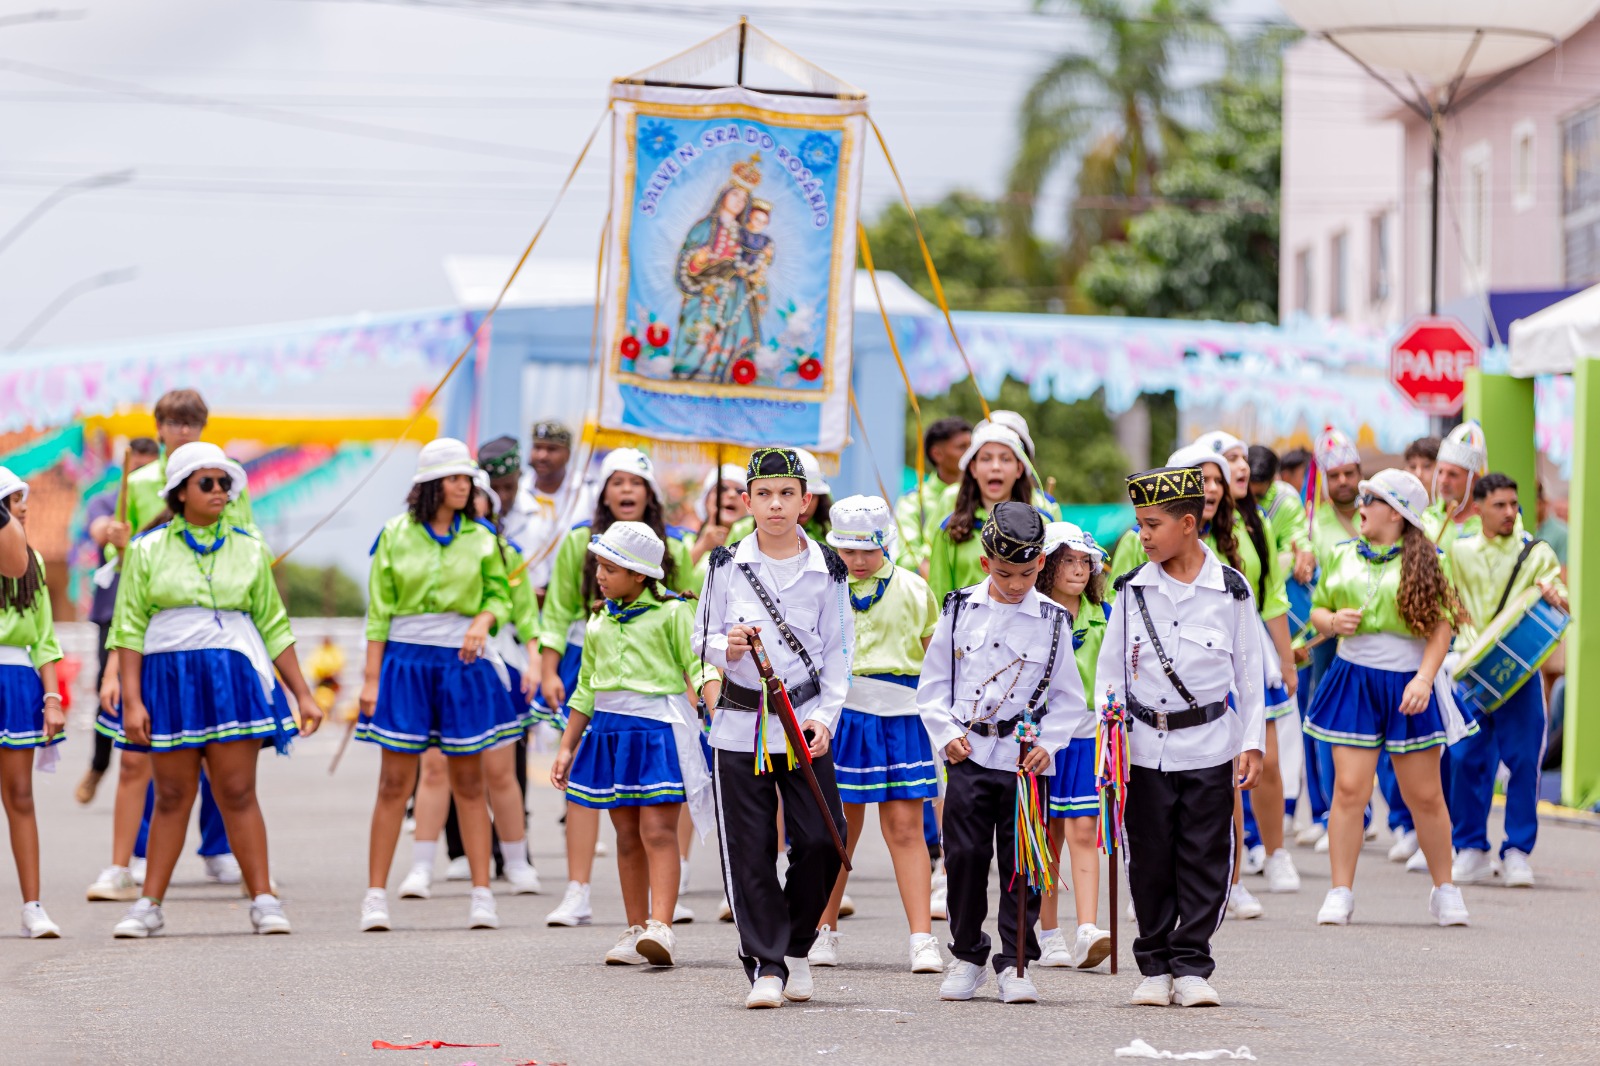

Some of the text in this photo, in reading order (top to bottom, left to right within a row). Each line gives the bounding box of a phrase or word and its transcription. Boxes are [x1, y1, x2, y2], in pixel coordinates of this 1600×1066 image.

[641, 158, 679, 214] SALVE
[704, 126, 739, 148] SRA
[744, 127, 773, 150] DO
